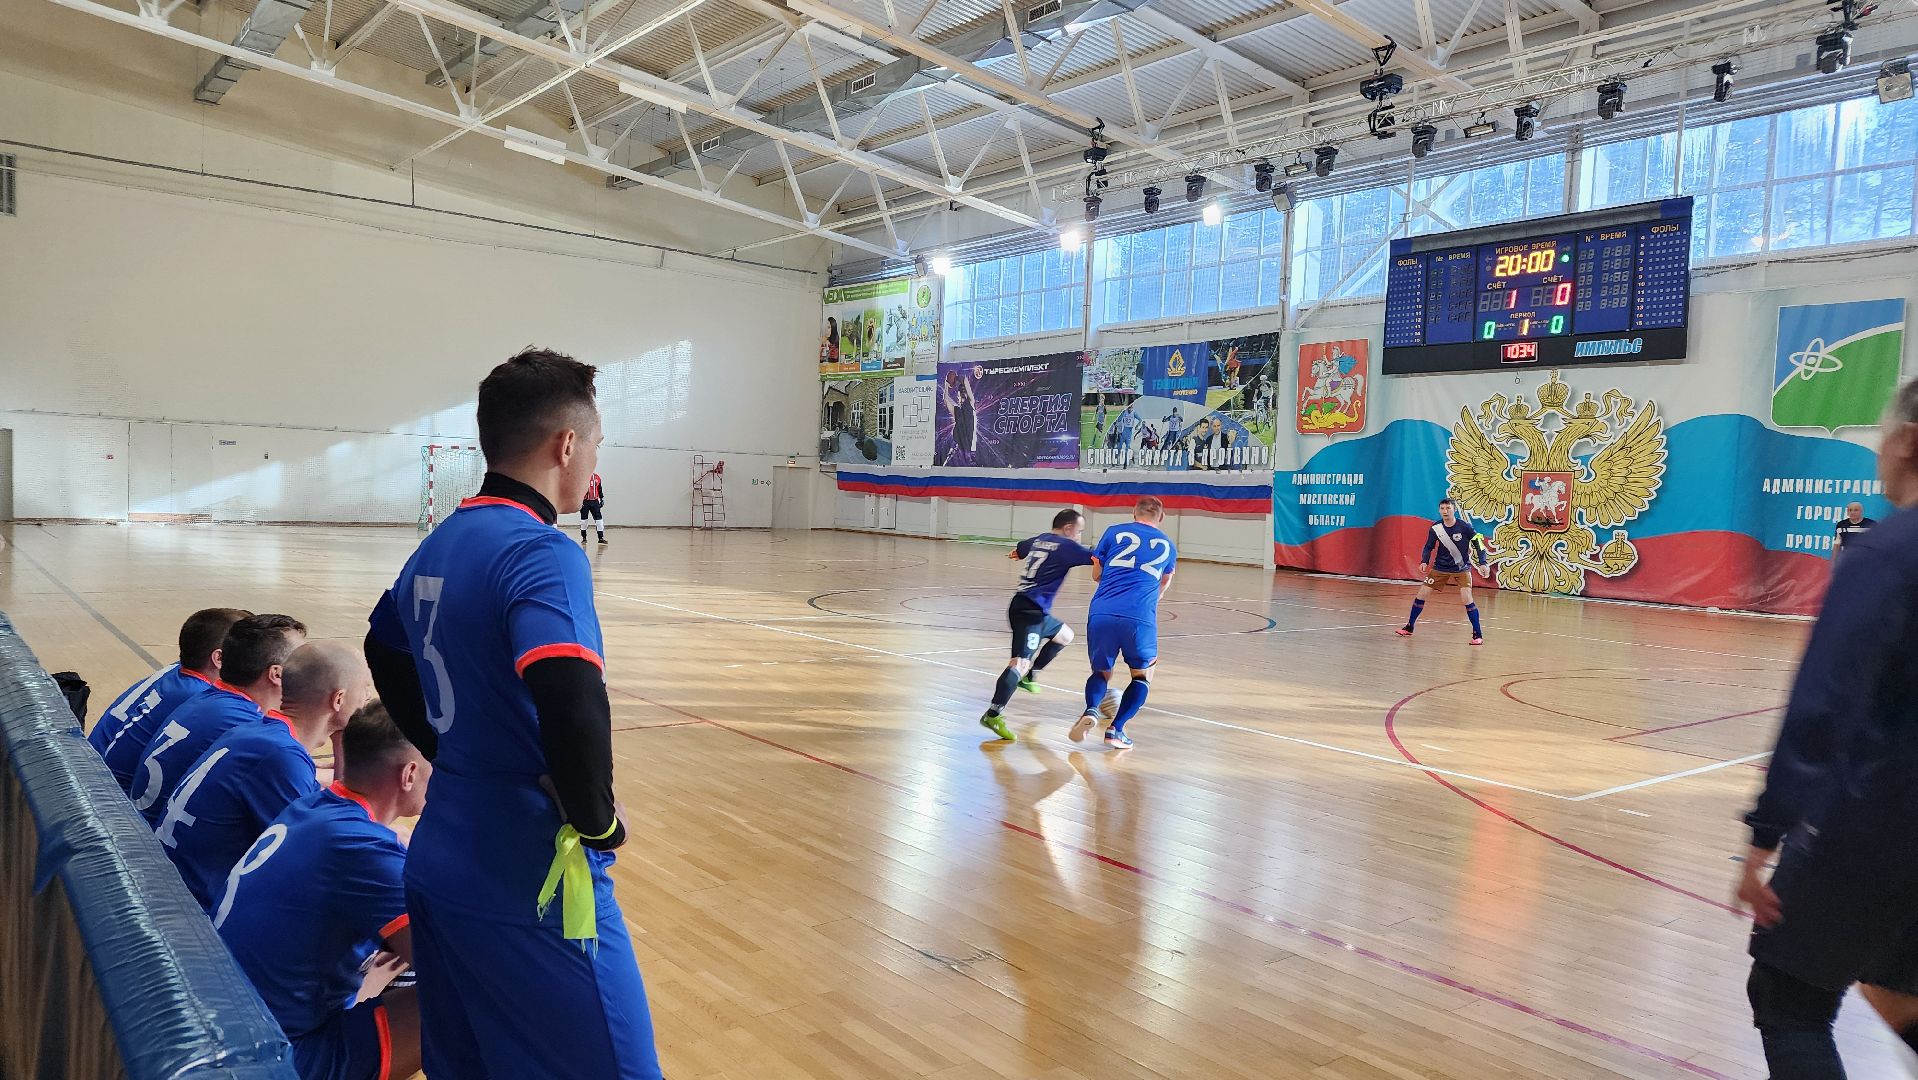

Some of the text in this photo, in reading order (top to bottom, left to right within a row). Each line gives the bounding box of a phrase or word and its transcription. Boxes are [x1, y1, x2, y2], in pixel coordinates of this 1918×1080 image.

[1600, 231, 1627, 241] ВРЕМЯ
[1651, 224, 1680, 234] ФОЛЫ
[1449, 252, 1470, 261] ВРЕМЯ
[1495, 241, 1557, 254] ИГРОВОЕ ВРЕМЯ
[1397, 258, 1418, 267] ФОЛЫ
[1494, 249, 1555, 277] 20:00
[1555, 282, 1571, 306] 0
[1510, 311, 1536, 320] ПЕРИОД
[1482, 320, 1496, 339] 0
[1550, 314, 1564, 334] 0
[1574, 338, 1643, 358] ИМПУЛЬС
[997, 392, 1073, 416] ЭНЕРГИЯ
[993, 412, 1068, 435] СПОРТА
[1291, 473, 1364, 487] АДМИНИСТРАЦИЯ
[1762, 478, 1887, 497] АДМИНИСТРАЦИ
[1299, 492, 1356, 506] МОСКОВСКОЙ
[1308, 514, 1346, 527] ОБЛАСТИ
[1108, 531, 1172, 581] 22
[413, 574, 456, 735] 3
[154, 750, 231, 849] 4
